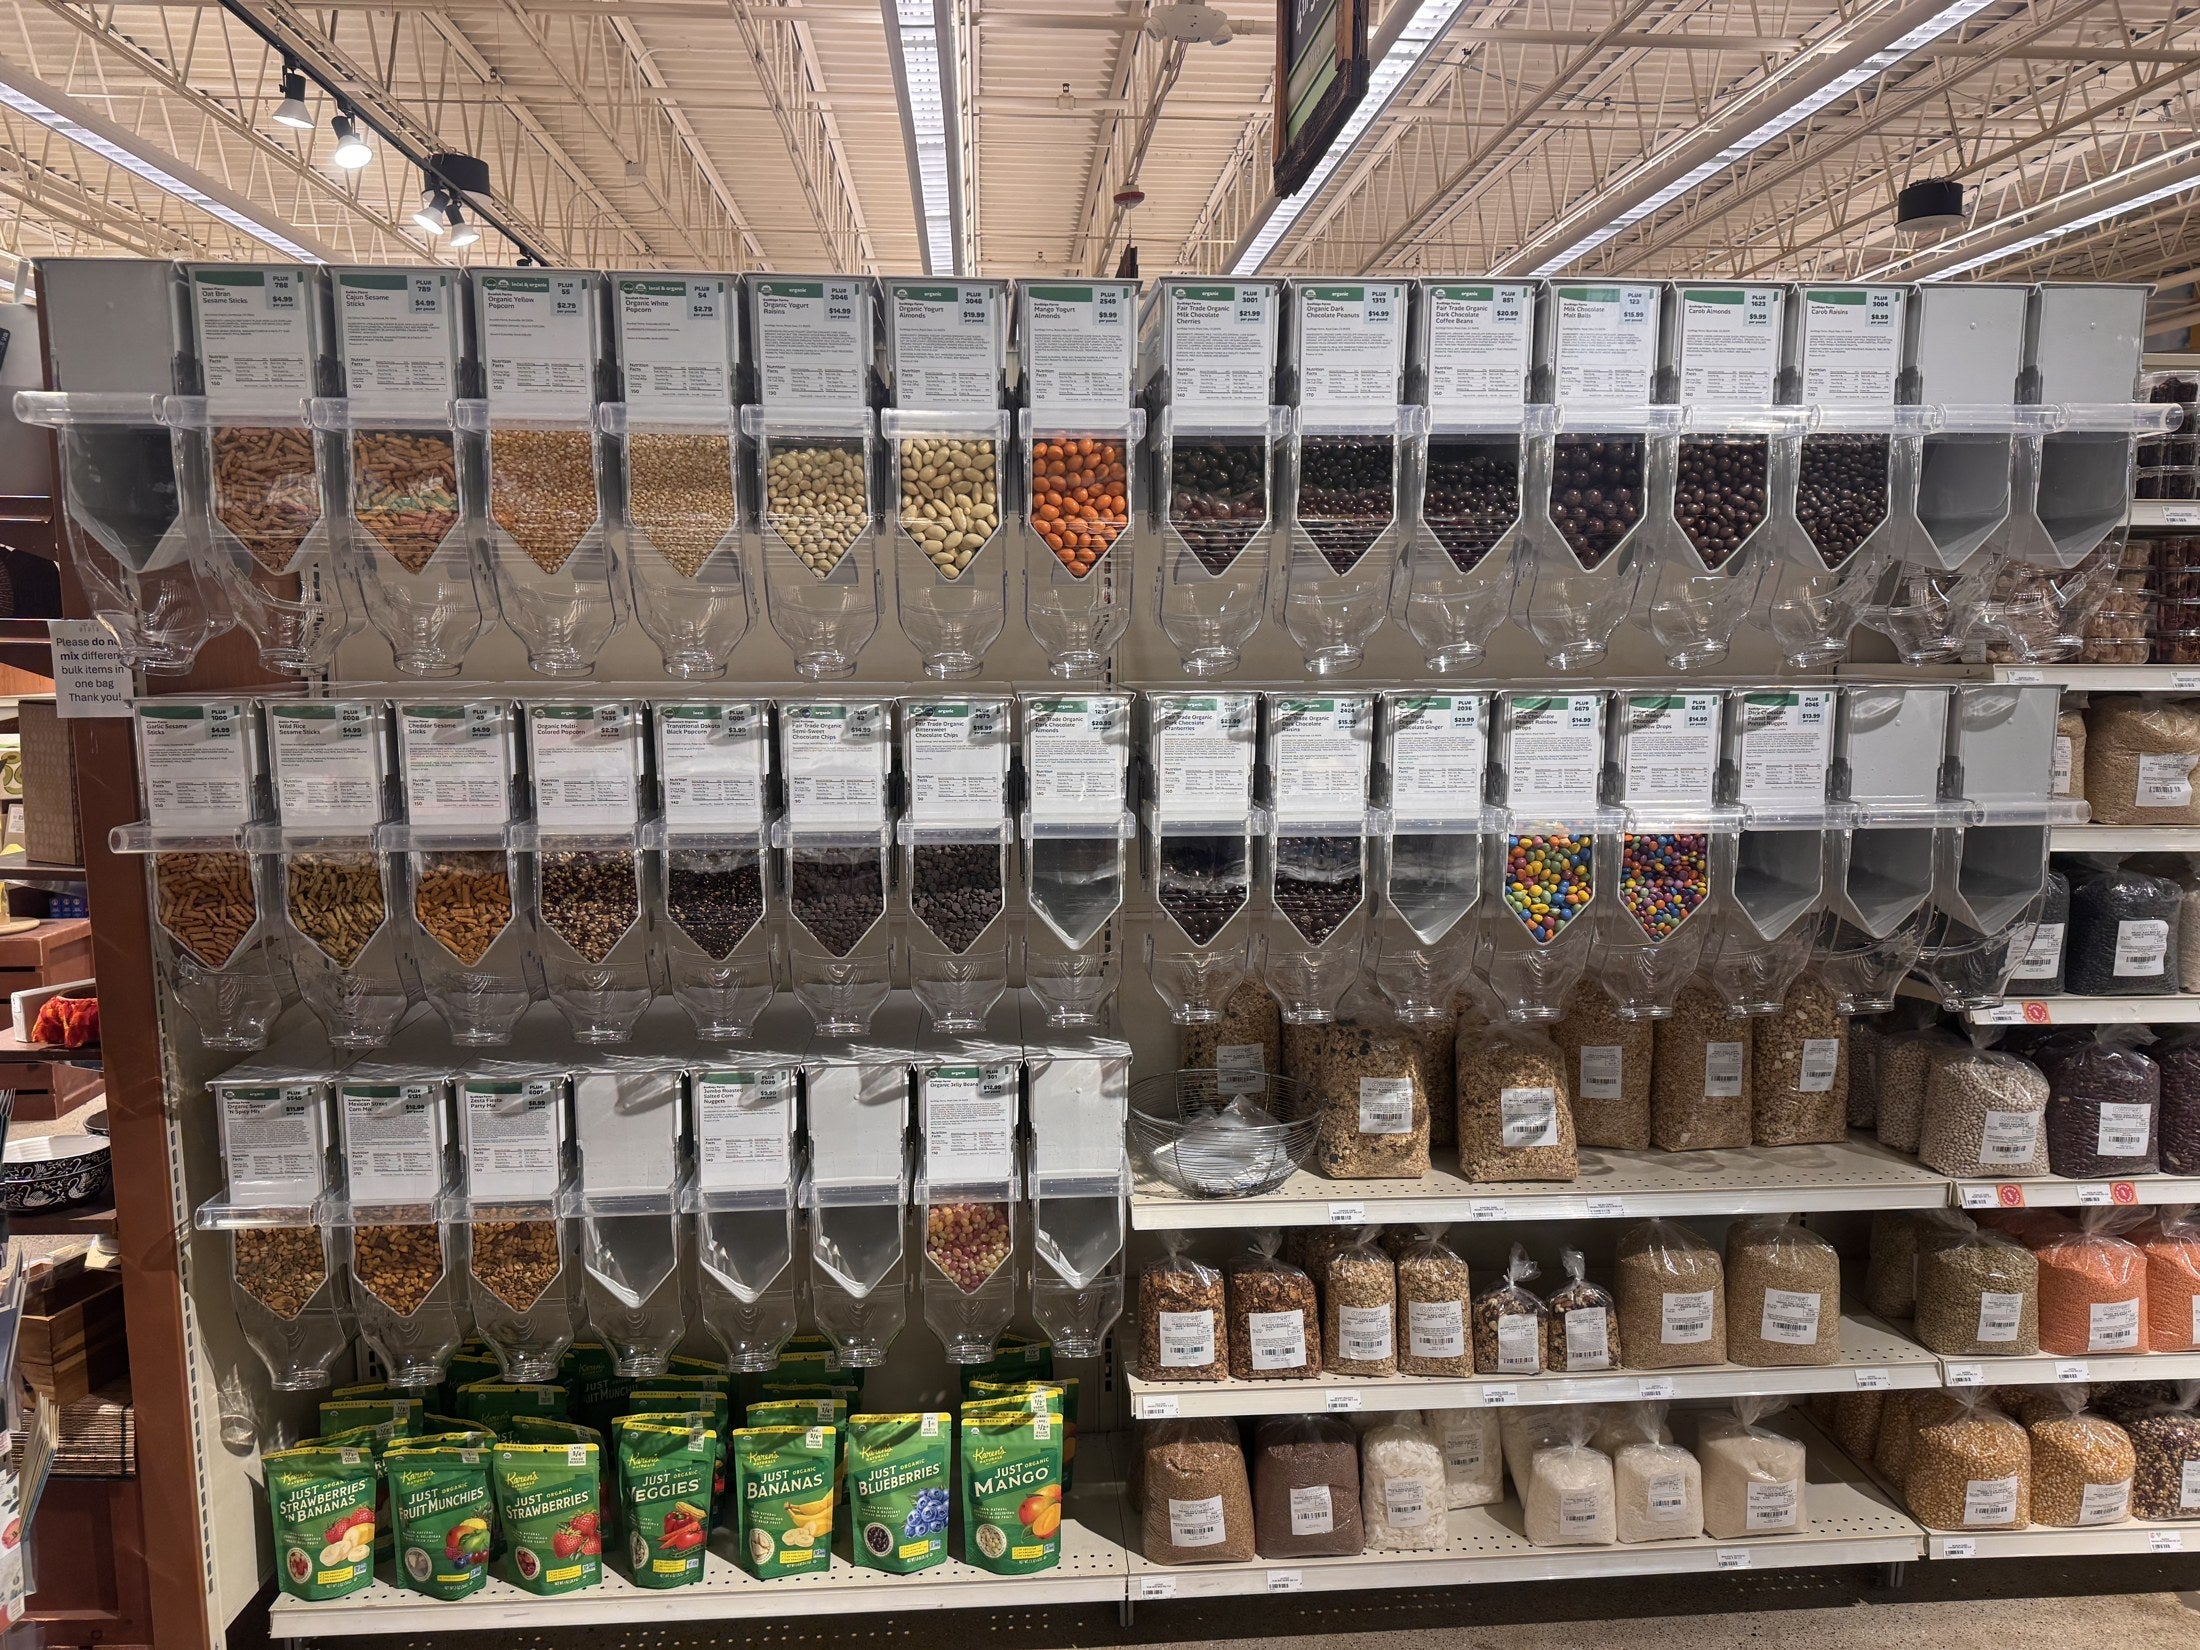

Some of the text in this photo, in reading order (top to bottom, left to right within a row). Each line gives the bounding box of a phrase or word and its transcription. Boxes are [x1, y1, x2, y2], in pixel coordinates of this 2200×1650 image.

[963, 311, 985, 319] $19.99
[1207, 305, 1230, 313] Organic
[1306, 305, 1330, 313] Organic
[56, 638, 90, 647] Please
[92, 638, 105, 646] do
[60, 652, 120, 660] mix differen
[61, 666, 83, 674] bulk
[95, 679, 114, 689] bag
[69, 692, 122, 703] Thank you!
[747, 1451, 780, 1463] Karen's
[860, 1444, 893, 1459] Karen's
[973, 1445, 1007, 1461] Karen's
[628, 1453, 661, 1467] Karen's
[995, 1457, 1049, 1479] JUST ORGANIC
[282, 1471, 315, 1484] Karen's
[401, 1470, 435, 1483] Karen's
[506, 1471, 540, 1485] Karen's
[761, 1467, 816, 1484] JUST ORGANIC
[869, 1459, 925, 1481] JUST ORGANIC
[642, 1470, 698, 1487] JUST ORGANIC
[858, 1463, 941, 1496] BLUEBERRIES
[974, 1467, 1049, 1498] MANGO
[289, 1478, 354, 1502] JUST ORGANIC
[409, 1482, 468, 1505] JUST ORGANIC
[747, 1476, 823, 1499] BANANAS
[279, 1479, 367, 1516] STRAWBERRIES
[398, 1487, 484, 1522] FRUIT MUNCHIES
[506, 1491, 589, 1519] STRAWBERRIES
[514, 1487, 573, 1507] JUST ORGANIC
[285, 1495, 356, 1523] 'N BANANAS
